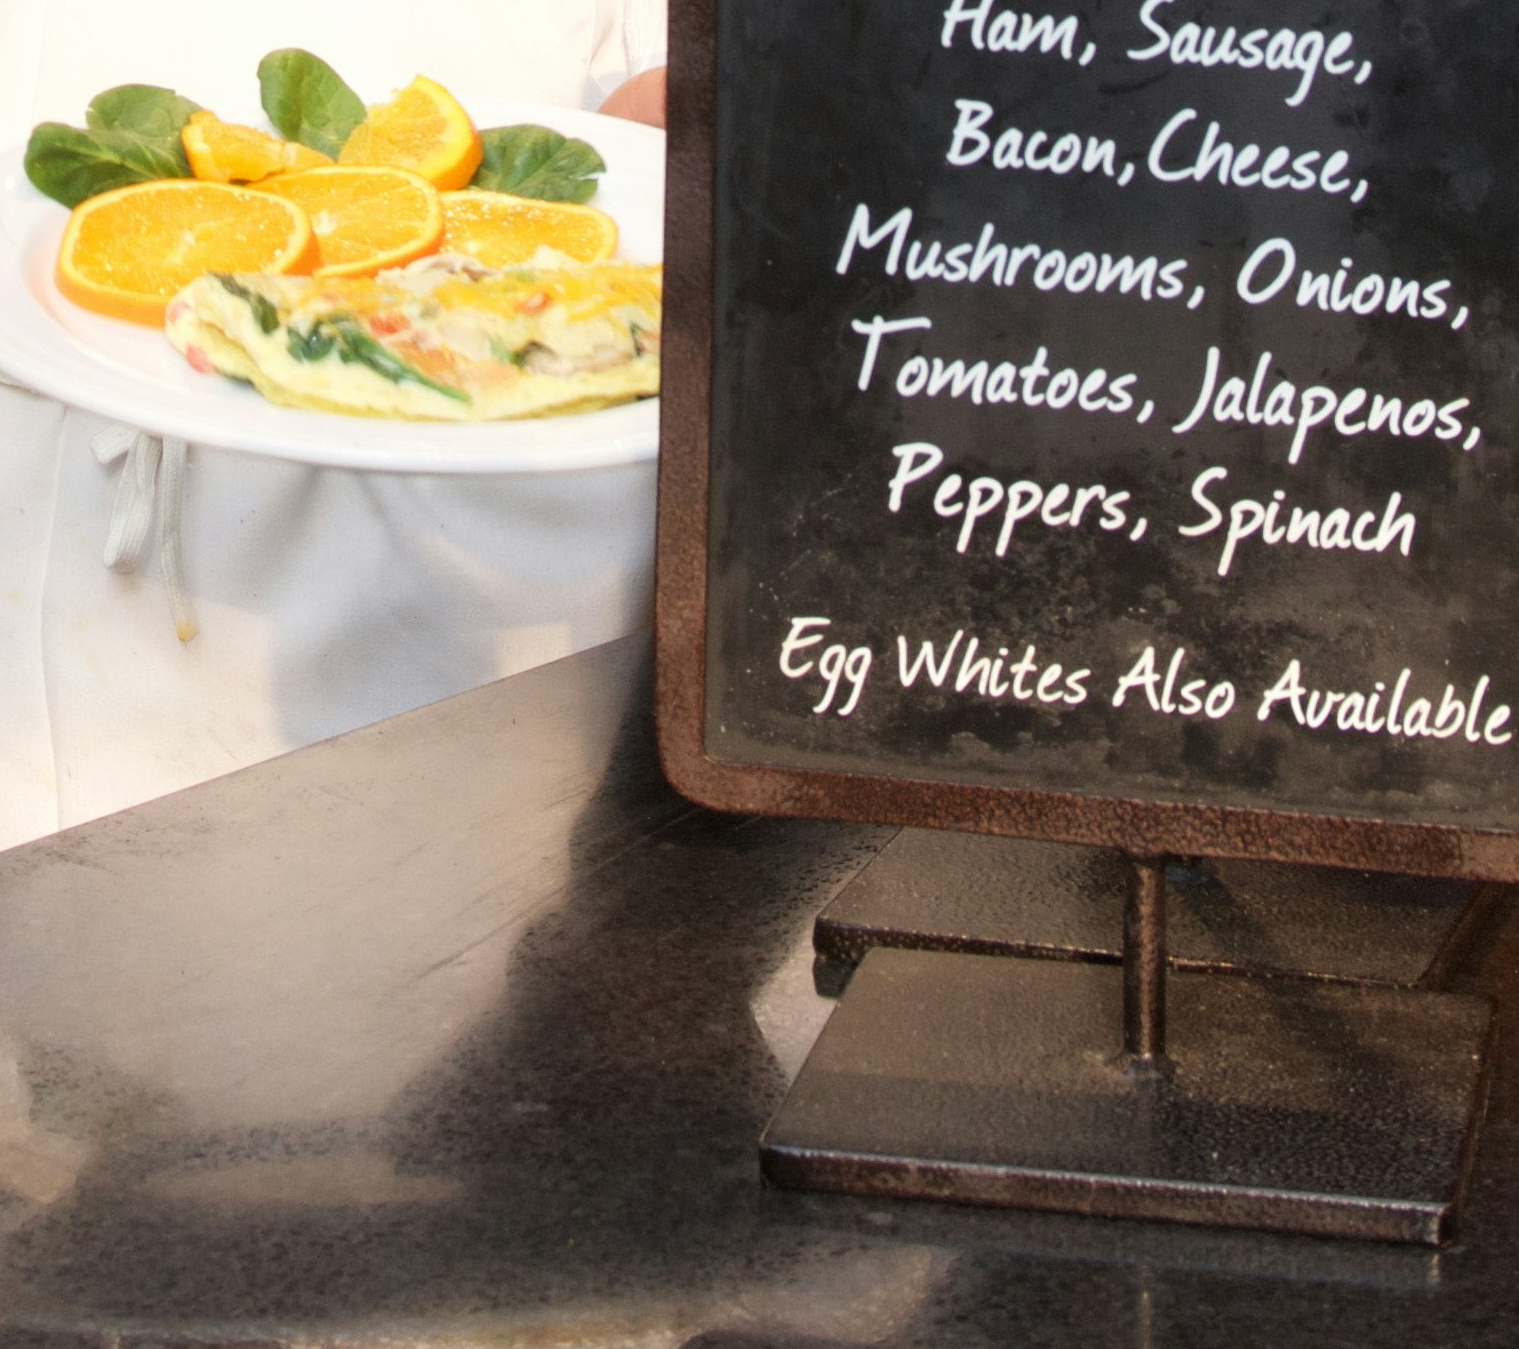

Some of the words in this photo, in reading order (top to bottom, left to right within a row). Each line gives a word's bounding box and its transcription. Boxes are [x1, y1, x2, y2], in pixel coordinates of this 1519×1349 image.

[945, 98, 1136, 186] Bacon,
[1146, 107, 1369, 204] Cheese,
[835, 202, 1206, 311] Mushrooms,
[1235, 236, 1470, 331] Onions,
[850, 314, 1156, 425] Tomatoes,
[1170, 345, 1482, 466] Jalapenos,
[887, 441, 1149, 558] Peppers,
[1177, 465, 1417, 578] Spinach
[778, 615, 873, 717] Egg
[896, 628, 1092, 705] Whites
[1111, 645, 1236, 720] Also
[1256, 658, 1513, 746] Available
